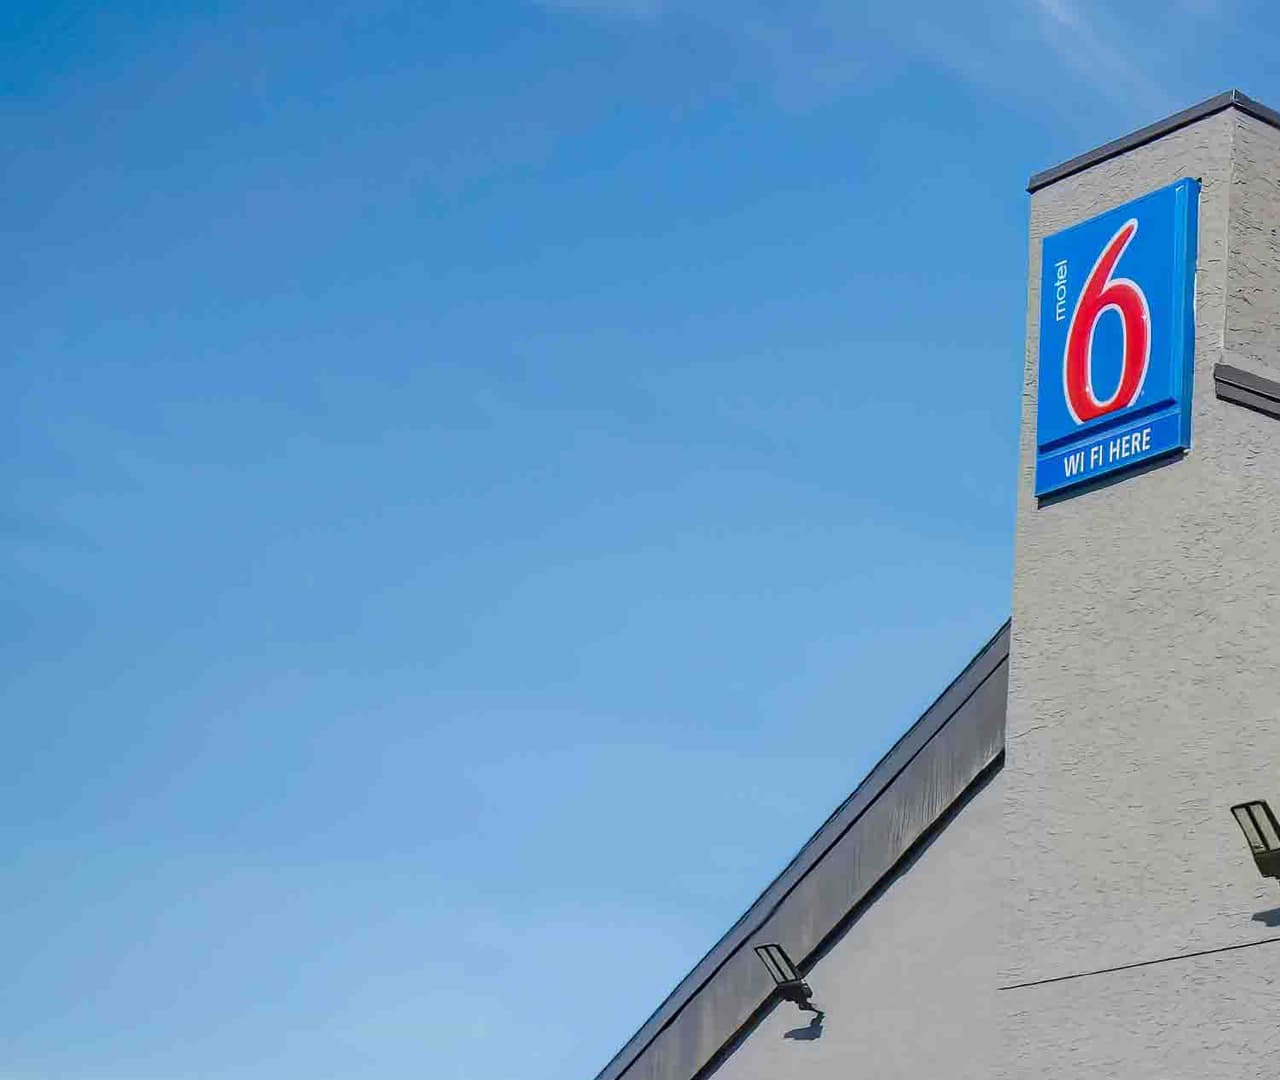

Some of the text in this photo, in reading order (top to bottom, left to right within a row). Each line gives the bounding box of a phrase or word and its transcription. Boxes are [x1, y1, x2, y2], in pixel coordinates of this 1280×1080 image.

[1055, 260, 1067, 321] motel
[1064, 218, 1151, 424] 6
[1064, 428, 1151, 477] WI FI HERE
